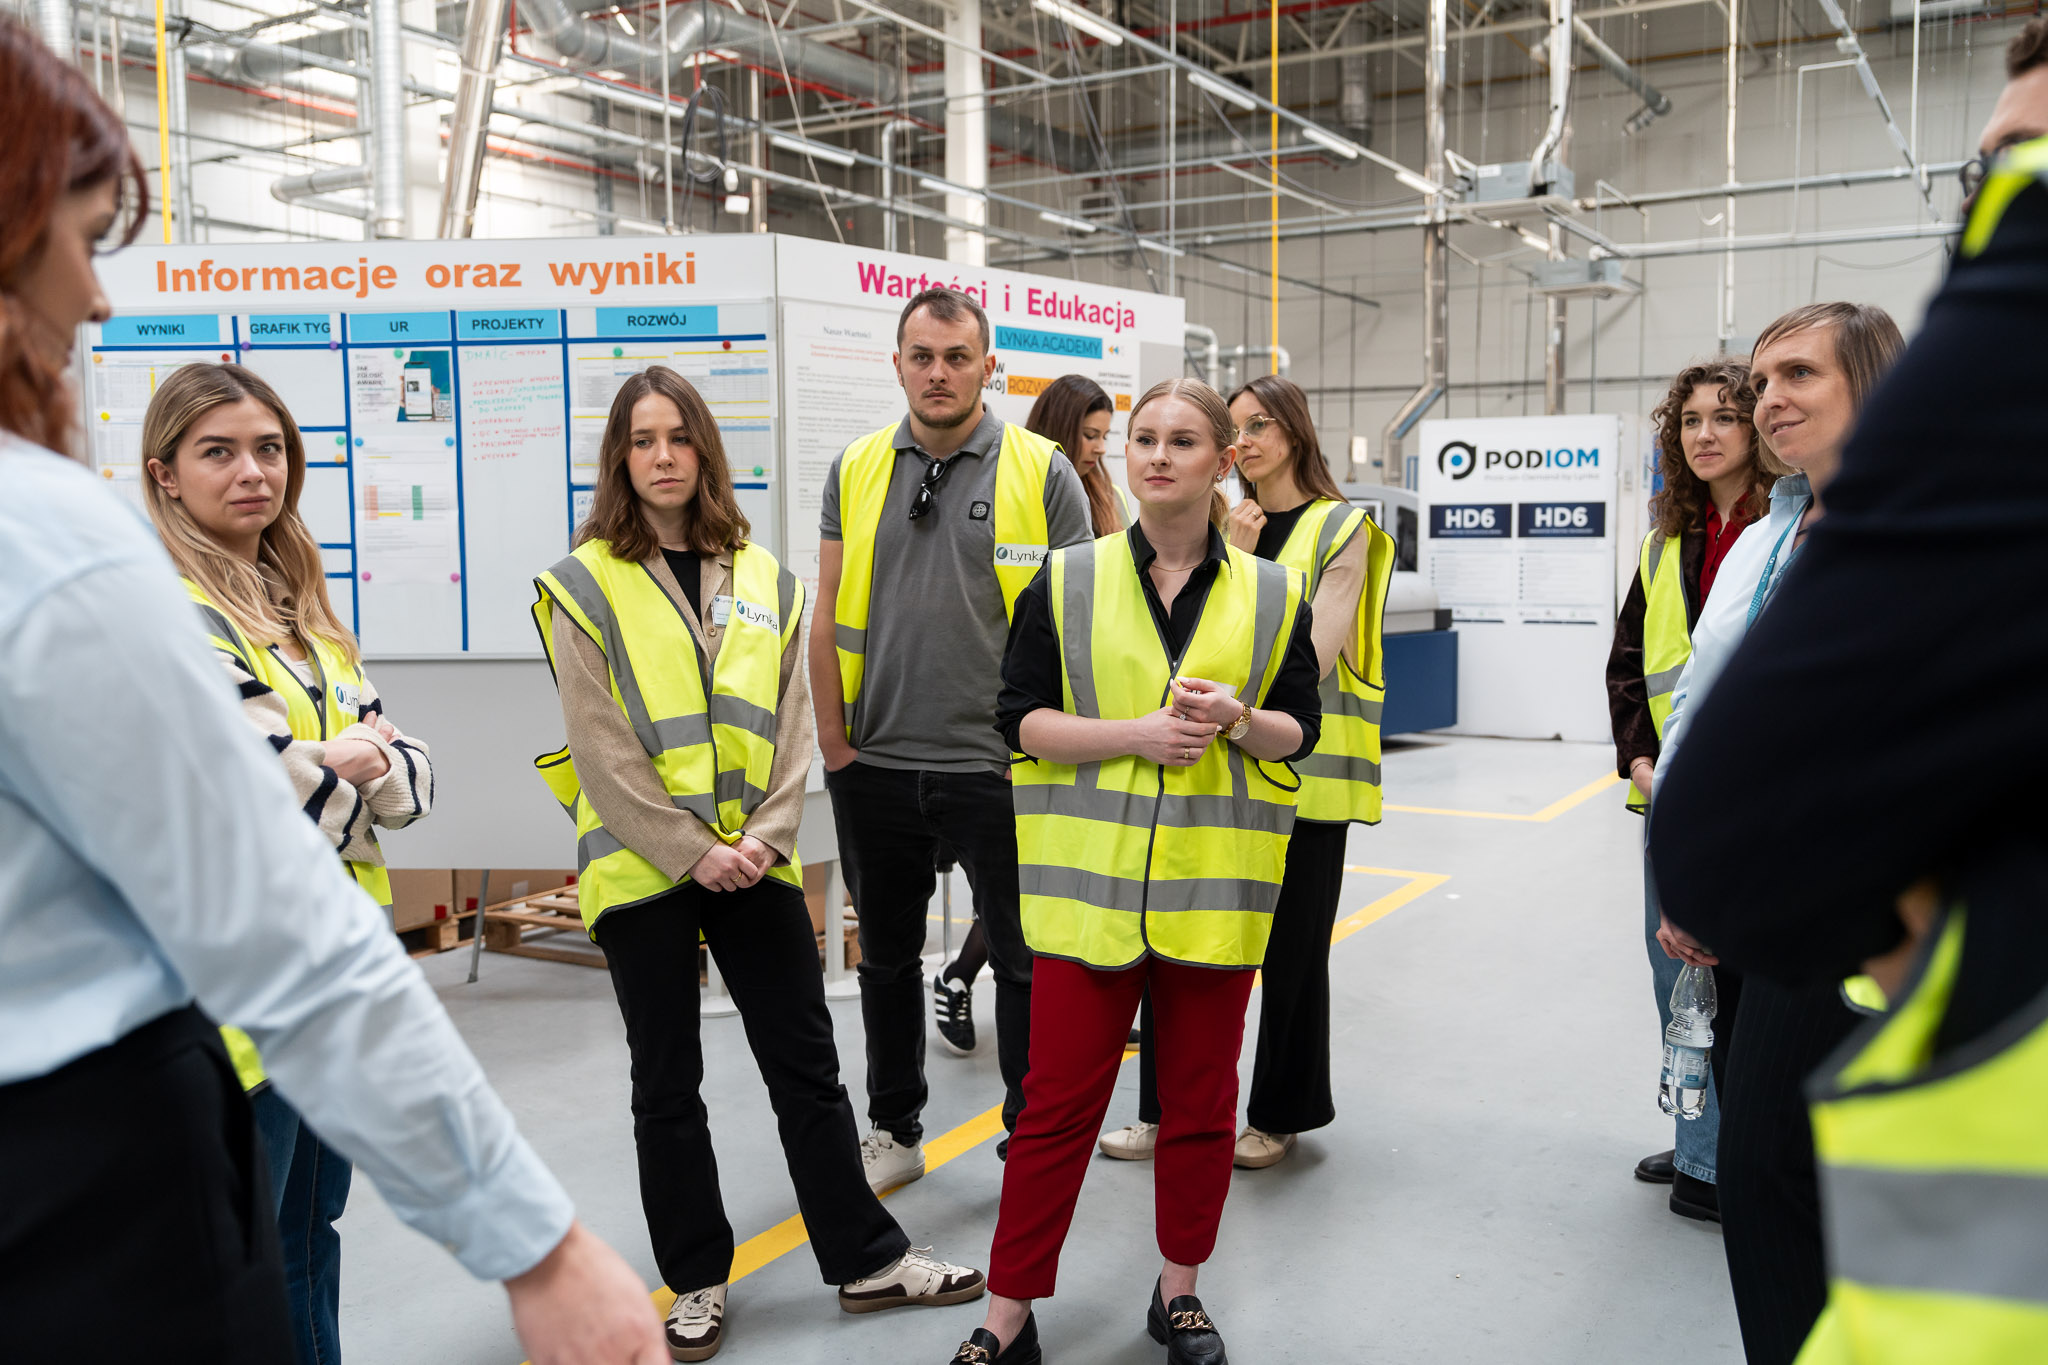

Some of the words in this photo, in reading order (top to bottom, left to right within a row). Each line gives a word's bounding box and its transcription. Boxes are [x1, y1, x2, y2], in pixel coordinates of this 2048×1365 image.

[157, 257, 397, 298] Informacje
[425, 263, 522, 288] oraz
[548, 251, 696, 295] wyniki
[1004, 283, 1011, 313] i
[1027, 287, 1136, 334] Edukacja
[136, 324, 185, 335] WYNIKI
[250, 323, 300, 335] GRAFIK
[305, 322, 331, 334] TYG
[389, 321, 409, 332] UR
[472, 318, 545, 330] PROJEKTY
[627, 313, 687, 326] ROZWÓJ
[999, 330, 1039, 348] LYNKA
[1041, 335, 1101, 355] ACADEMY
[1485, 448, 1600, 469] PODIOM
[1445, 507, 1496, 529] HD6
[1534, 506, 1588, 528] HD6
[1010, 550, 1046, 563] Lynka
[747, 607, 778, 630] Lynka
